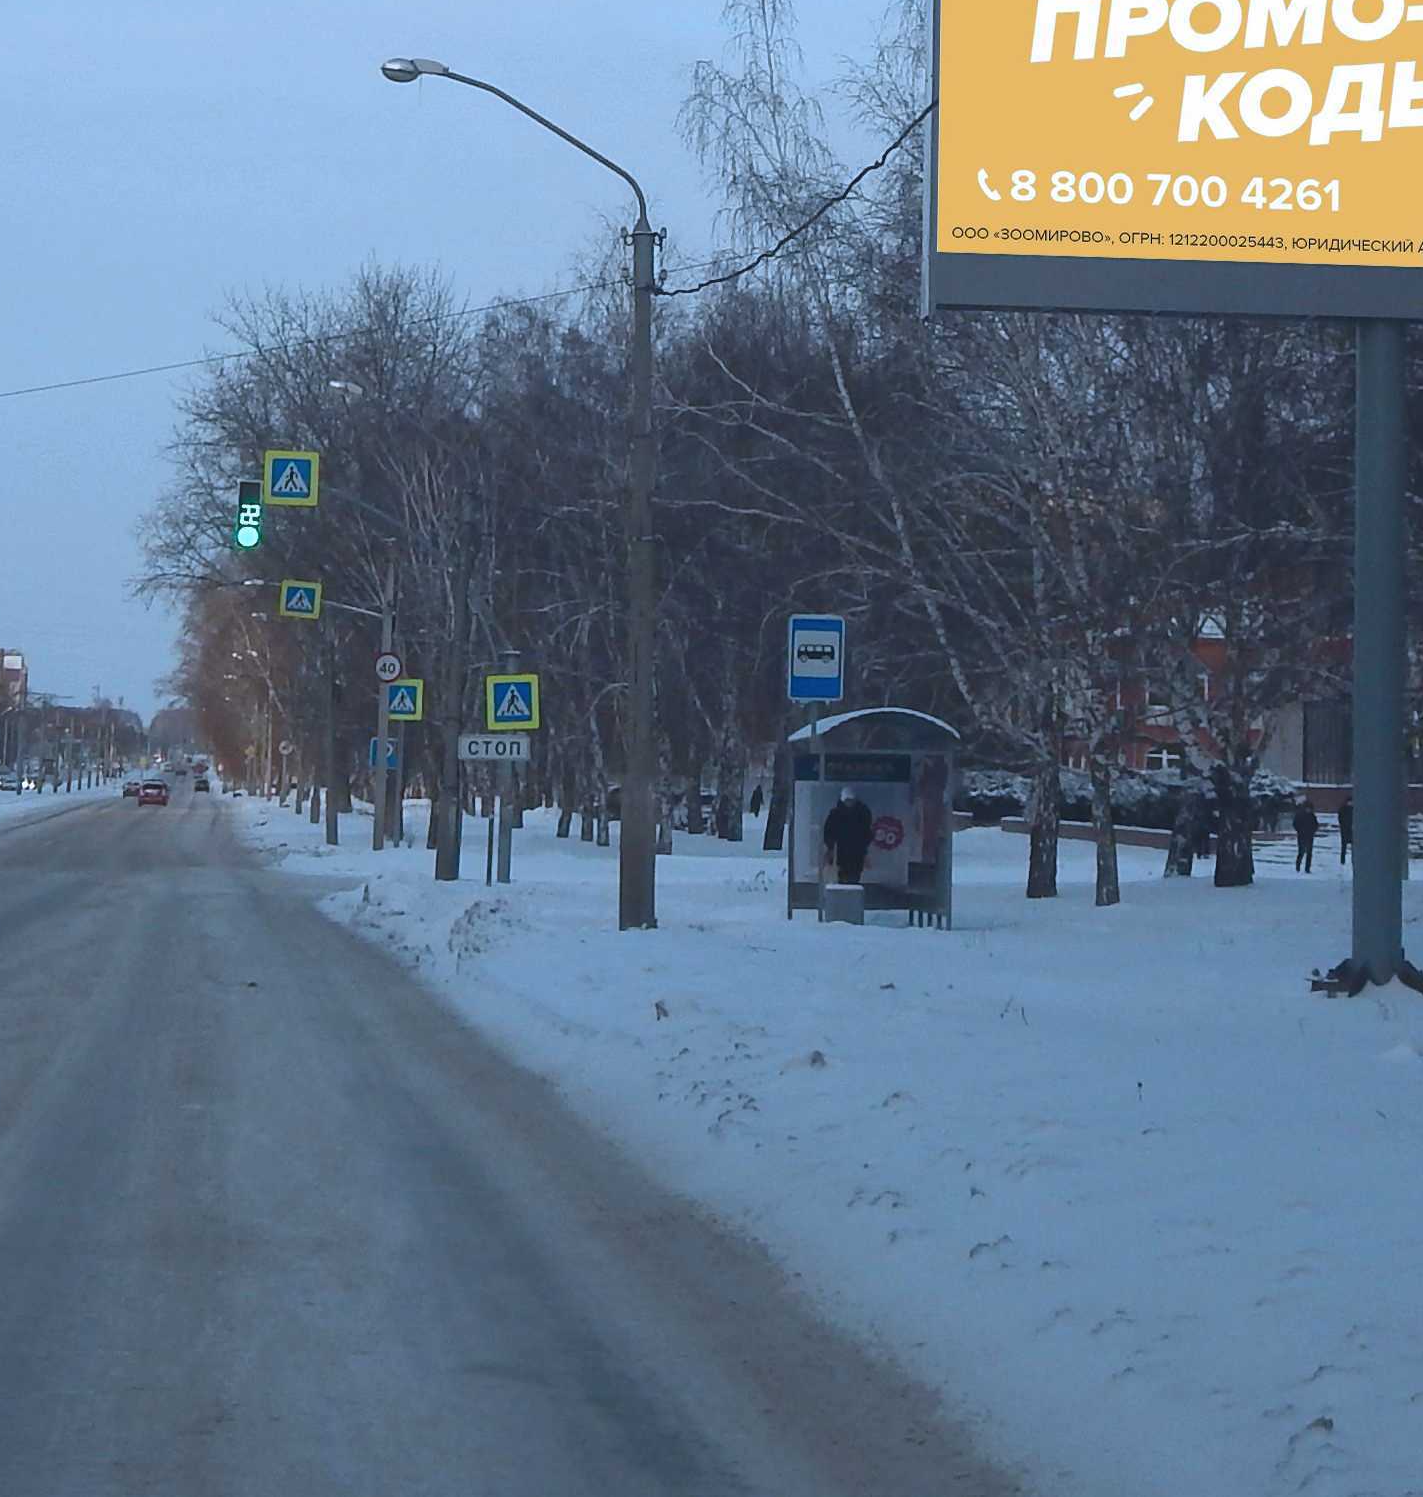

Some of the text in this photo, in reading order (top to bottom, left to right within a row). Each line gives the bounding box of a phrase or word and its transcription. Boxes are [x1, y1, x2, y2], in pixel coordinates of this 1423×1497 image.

[1010, 170, 1342, 211] 8 800 700 4261
[951, 226, 990, 240] ООО
[992, 227, 1116, 245] «ЗООМИРОВО»,
[1117, 232, 1166, 246] ОГРН:
[1169, 233, 1288, 251] 1212200025443,
[1291, 235, 1414, 255] ЮРИДИЧЕСКИЙ
[379, 661, 397, 675] 40
[467, 740, 522, 757] СТОП
